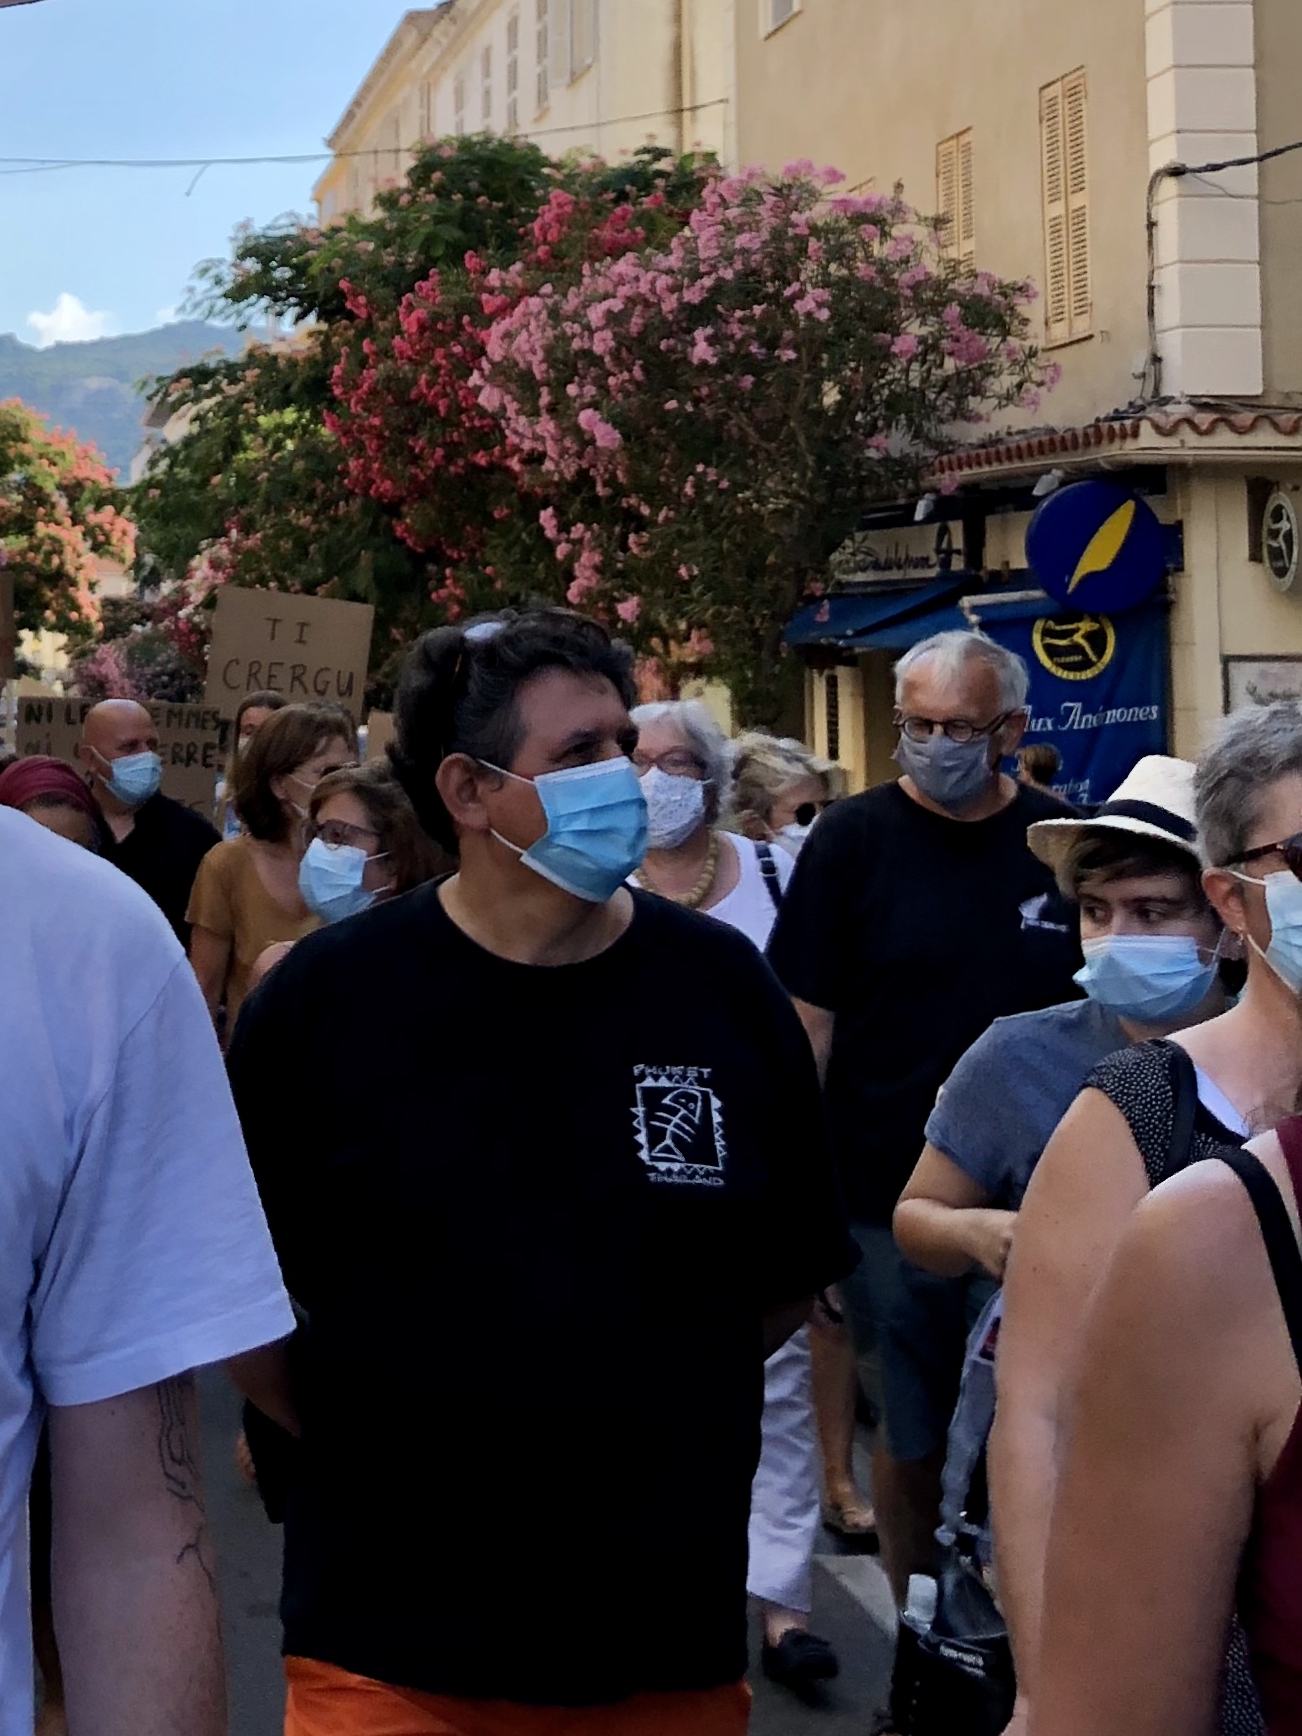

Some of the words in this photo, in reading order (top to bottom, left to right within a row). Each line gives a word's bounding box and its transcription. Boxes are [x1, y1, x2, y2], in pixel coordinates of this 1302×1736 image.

[264, 617, 311, 645] TI
[222, 657, 355, 698] CRERGU
[150, 707, 221, 731] EMMES
